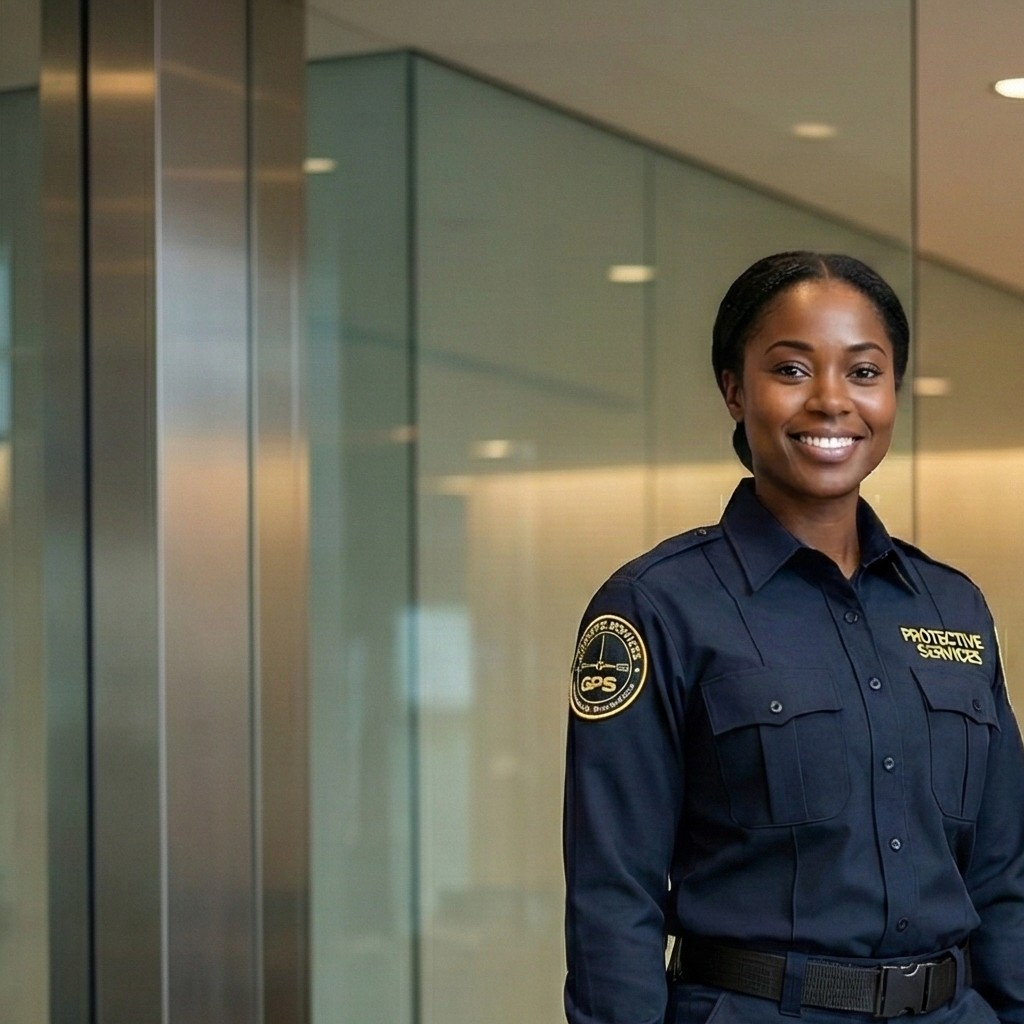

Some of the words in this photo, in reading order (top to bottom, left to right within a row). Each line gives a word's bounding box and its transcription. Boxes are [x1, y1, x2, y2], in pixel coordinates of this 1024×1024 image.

[900, 627, 985, 650] PROTECTIVE
[916, 643, 983, 665] SERVICES
[581, 675, 617, 693] GPS
